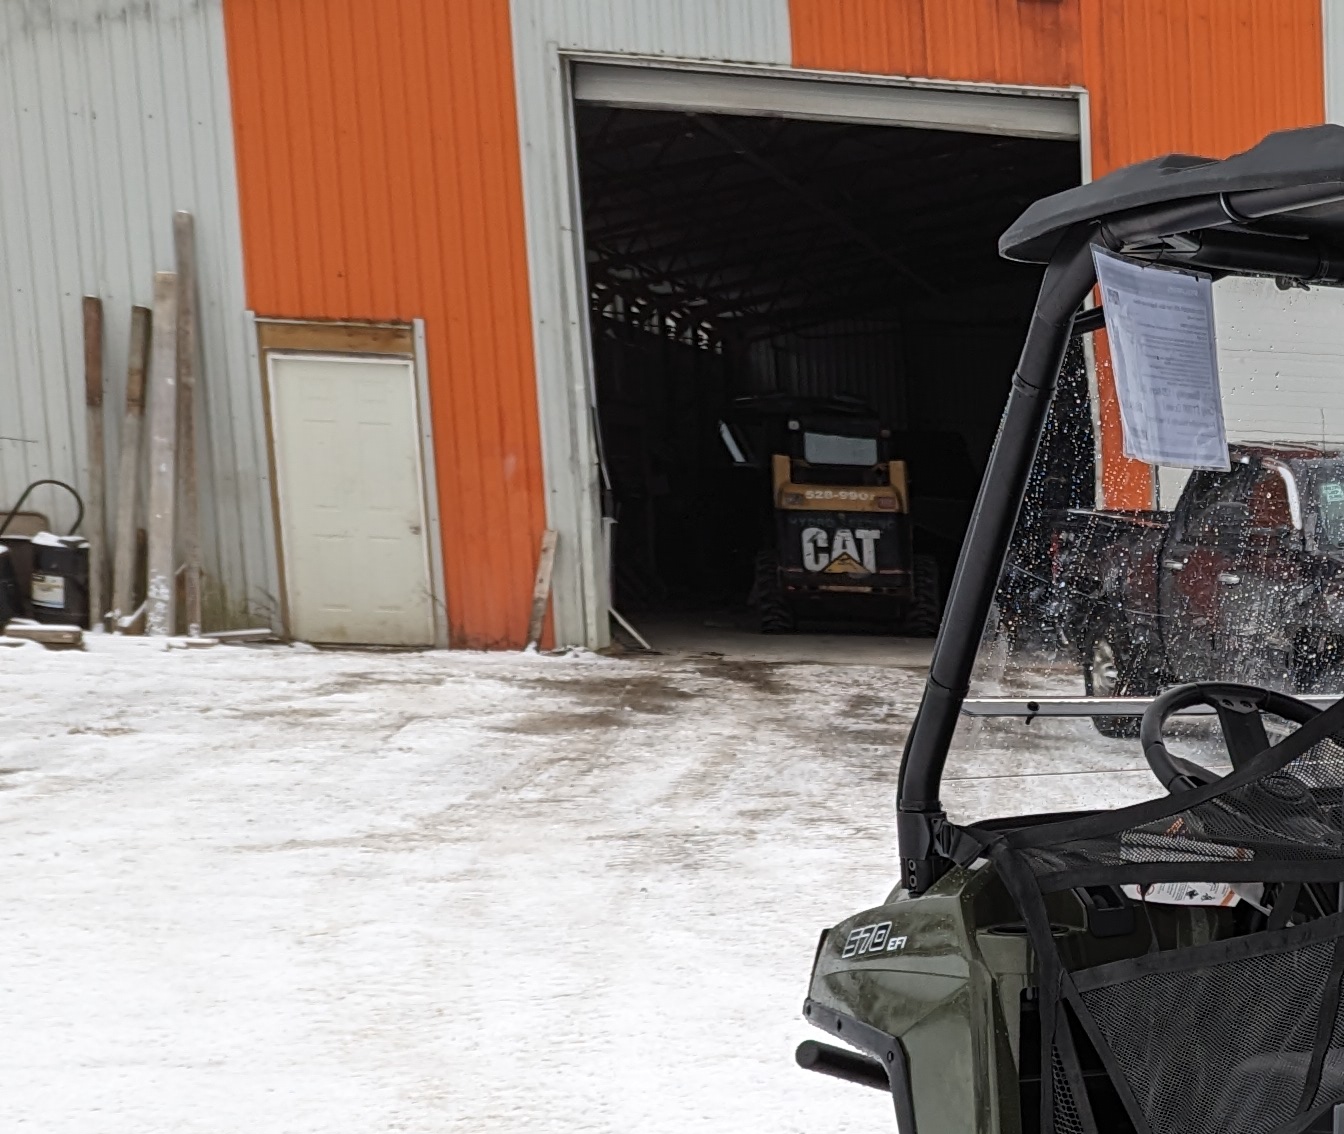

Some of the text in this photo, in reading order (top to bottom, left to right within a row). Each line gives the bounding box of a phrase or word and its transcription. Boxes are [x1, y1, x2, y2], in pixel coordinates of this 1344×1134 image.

[802, 527, 881, 573] CAT
[842, 921, 908, 958] 570 EFI
